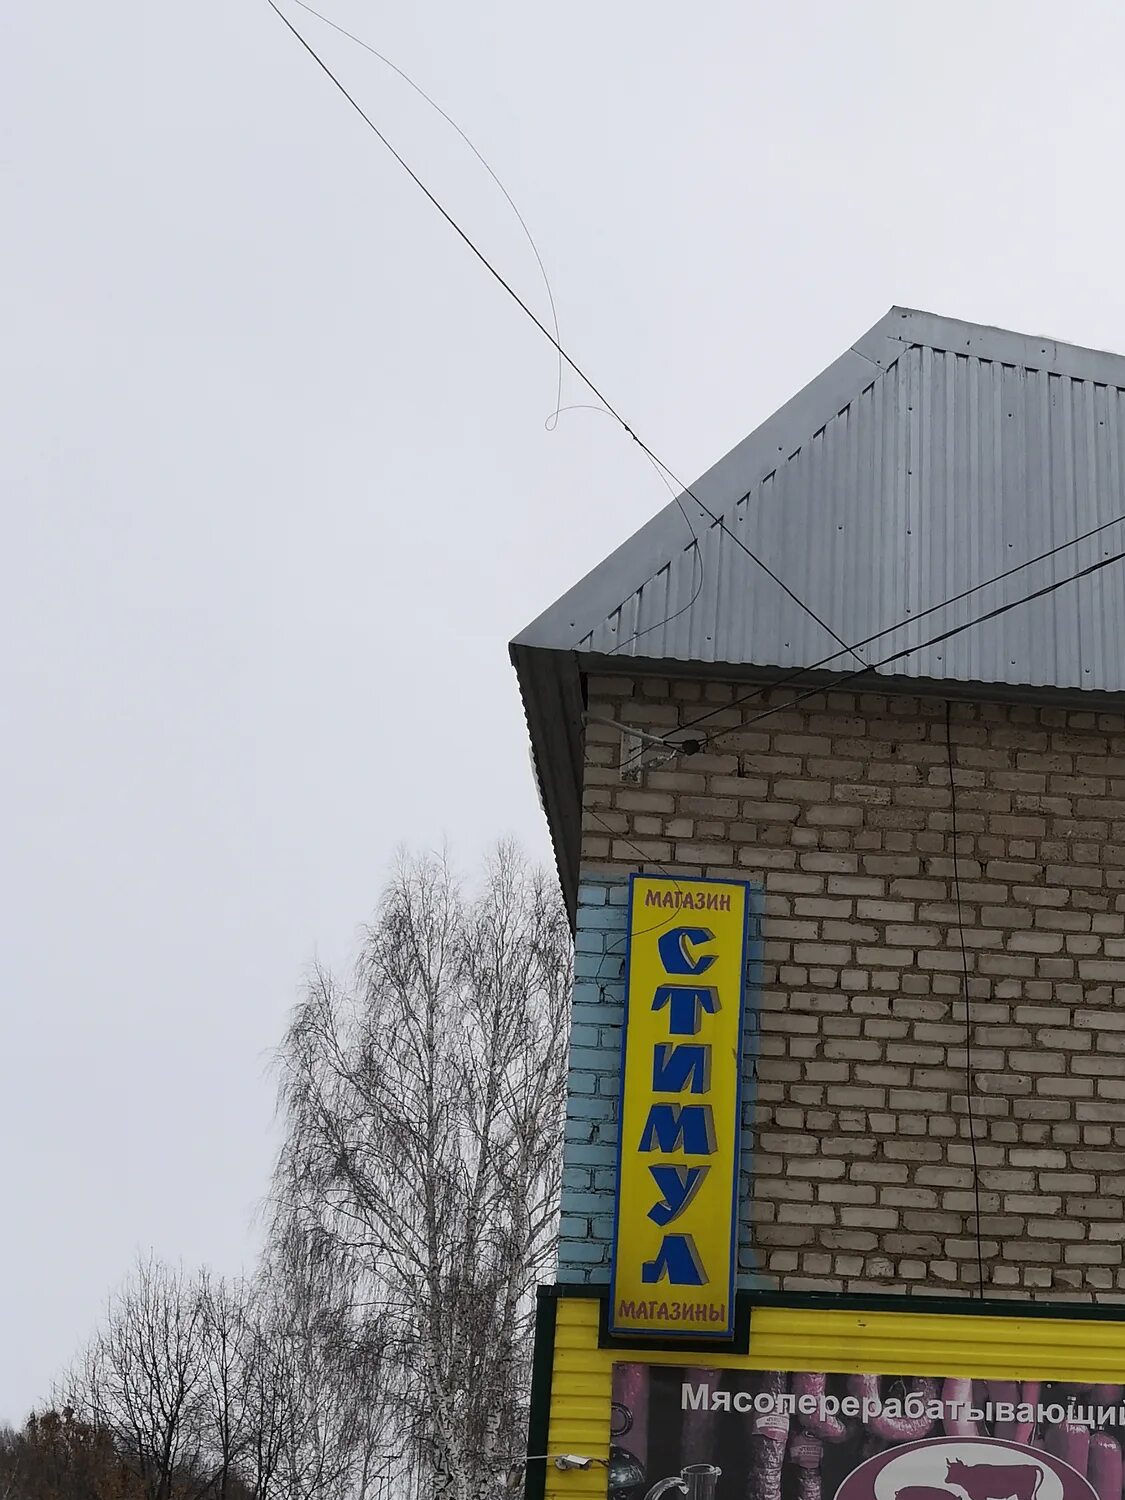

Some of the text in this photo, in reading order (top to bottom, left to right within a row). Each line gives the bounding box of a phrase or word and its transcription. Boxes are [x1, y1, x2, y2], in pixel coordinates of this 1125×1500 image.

[644, 889, 731, 911] МАГАЗИН
[638, 926, 722, 1286] СТИМУЛ
[618, 1300, 726, 1323] МАГАЗИНЫ
